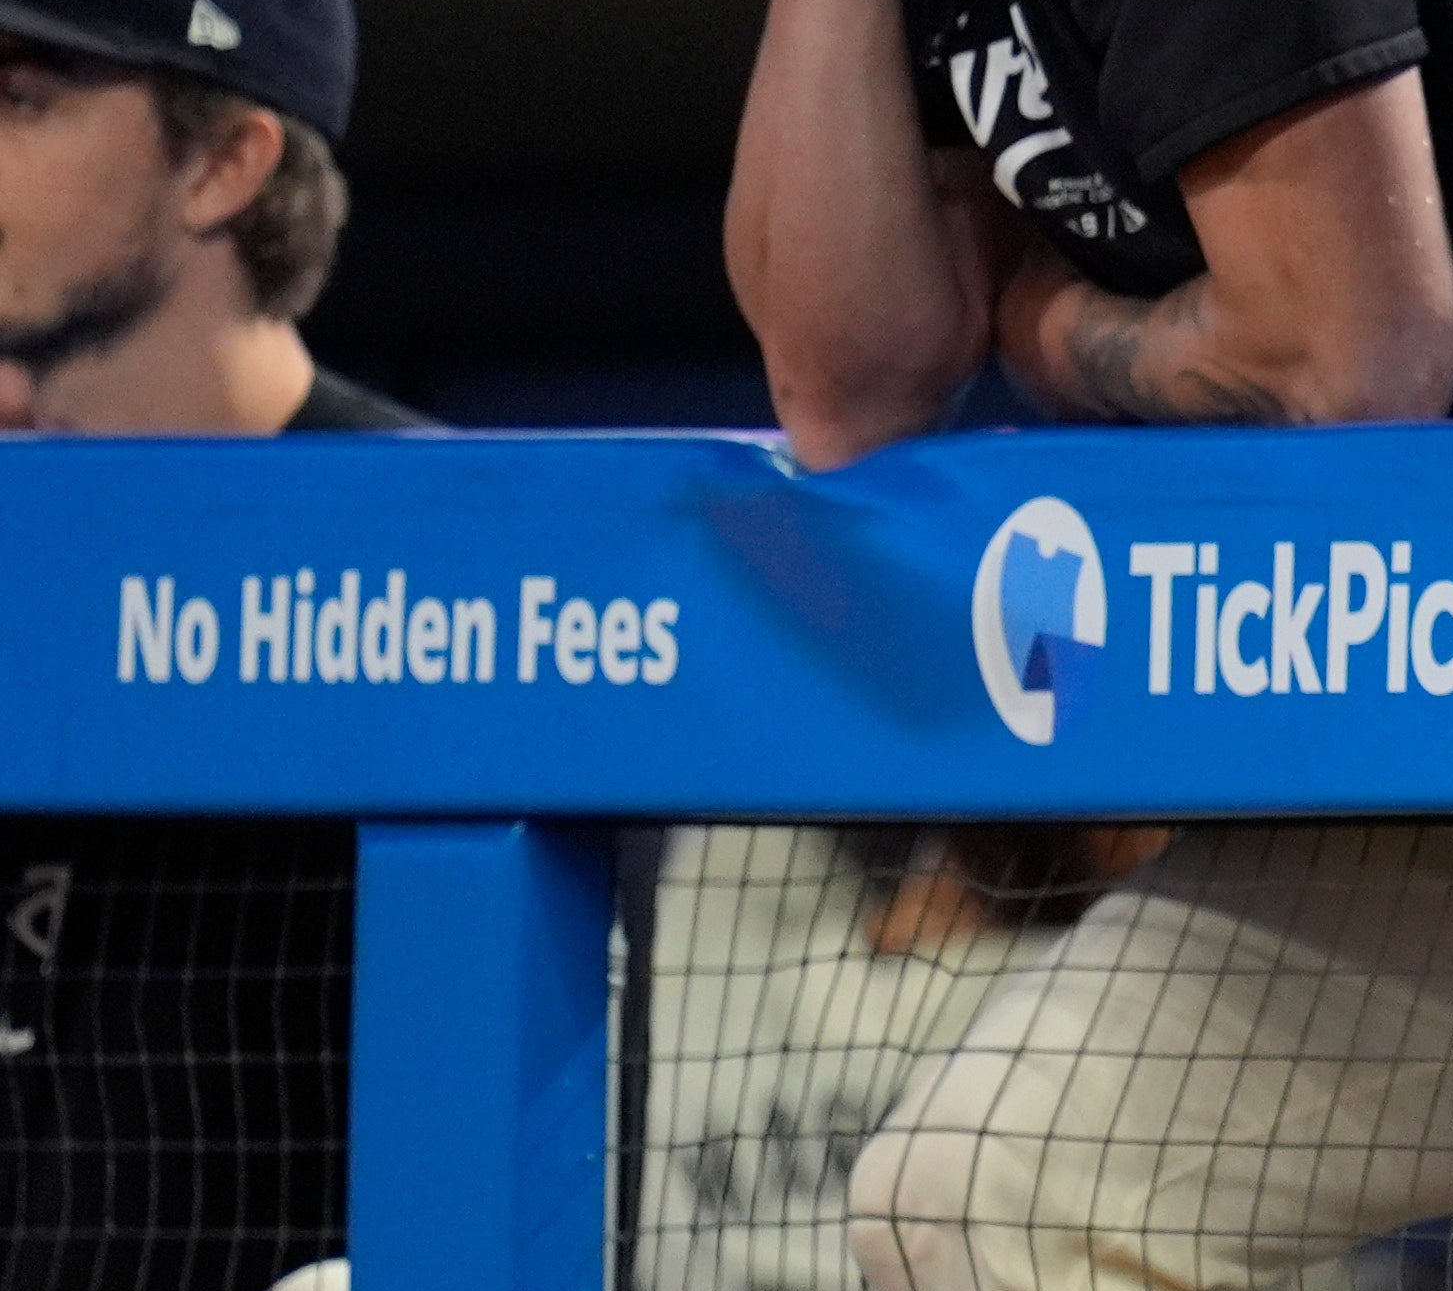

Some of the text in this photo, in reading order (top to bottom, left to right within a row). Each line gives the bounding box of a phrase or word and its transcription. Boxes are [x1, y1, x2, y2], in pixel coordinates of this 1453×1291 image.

[118, 568, 680, 686] No Hidden Fees
